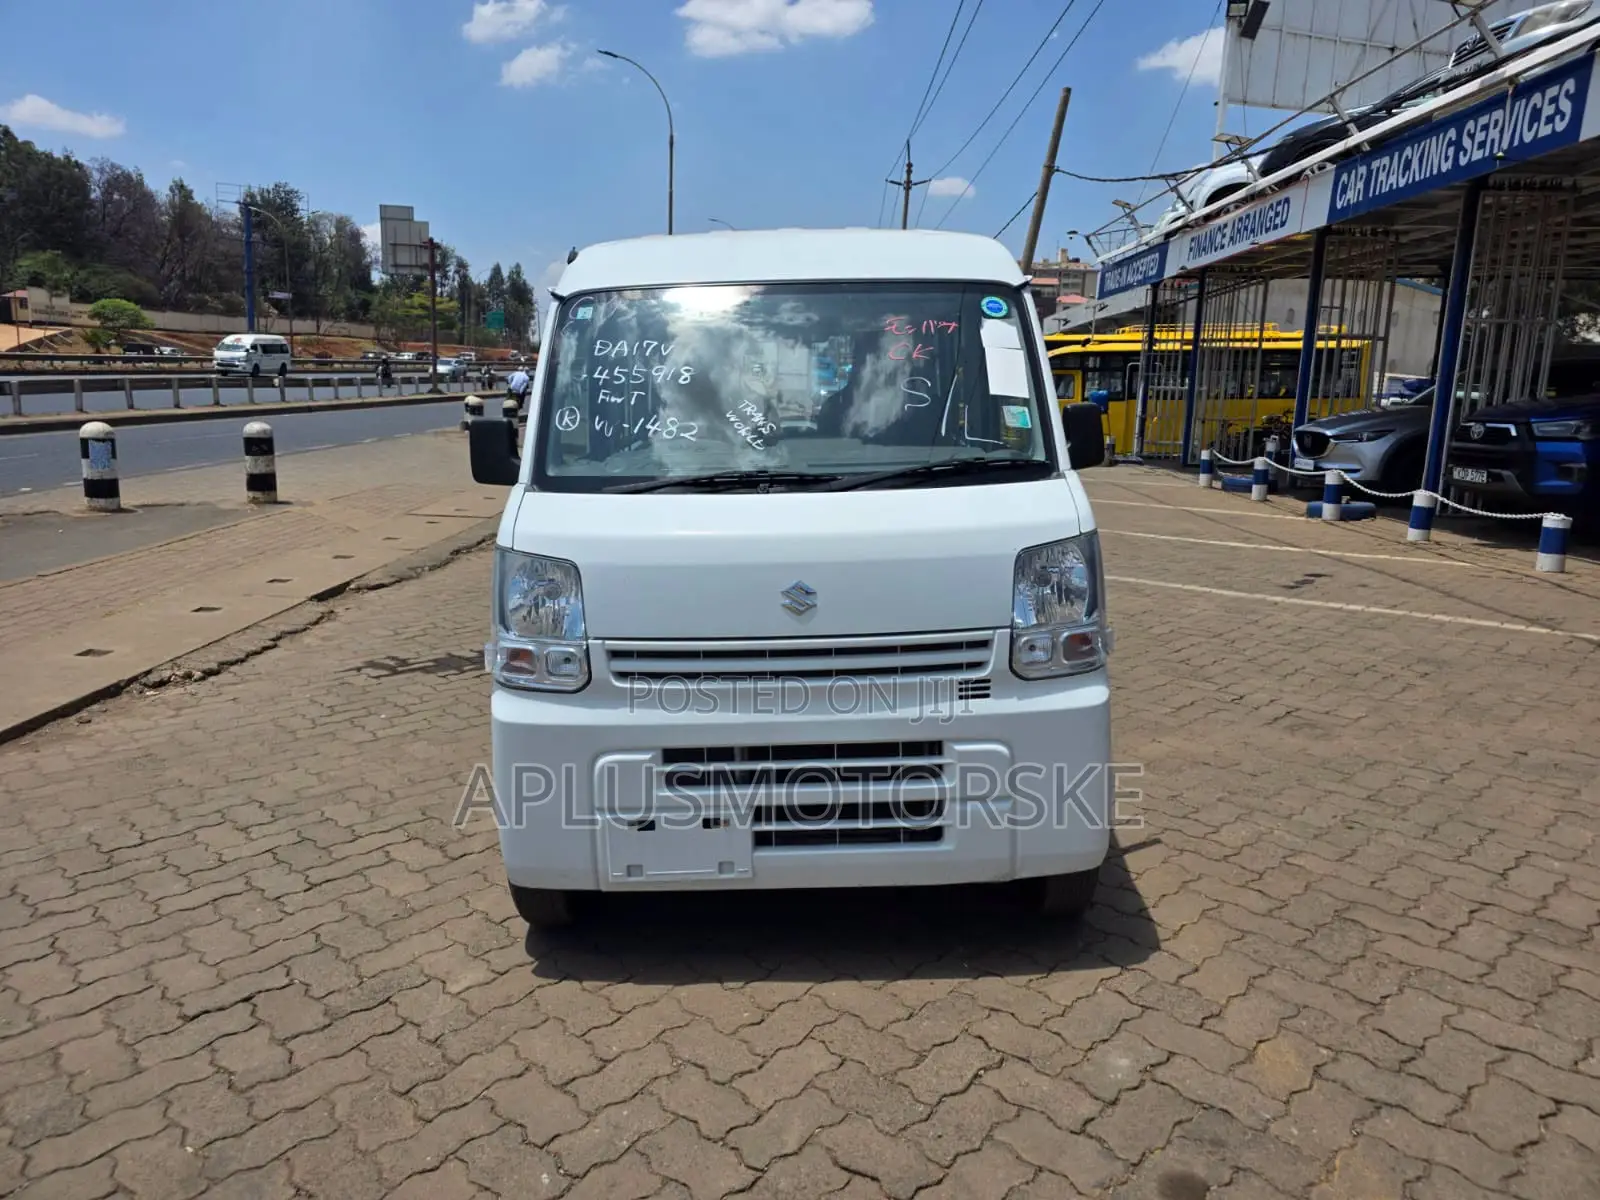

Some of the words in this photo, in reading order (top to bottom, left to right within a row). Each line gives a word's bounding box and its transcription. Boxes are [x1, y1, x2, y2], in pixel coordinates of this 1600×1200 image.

[1336, 165, 1366, 209] CAR
[1368, 128, 1456, 198] TRACKING
[1458, 78, 1576, 166] SERVICES
[1187, 223, 1228, 262] FINANCE
[1227, 196, 1291, 248] ARRANGED
